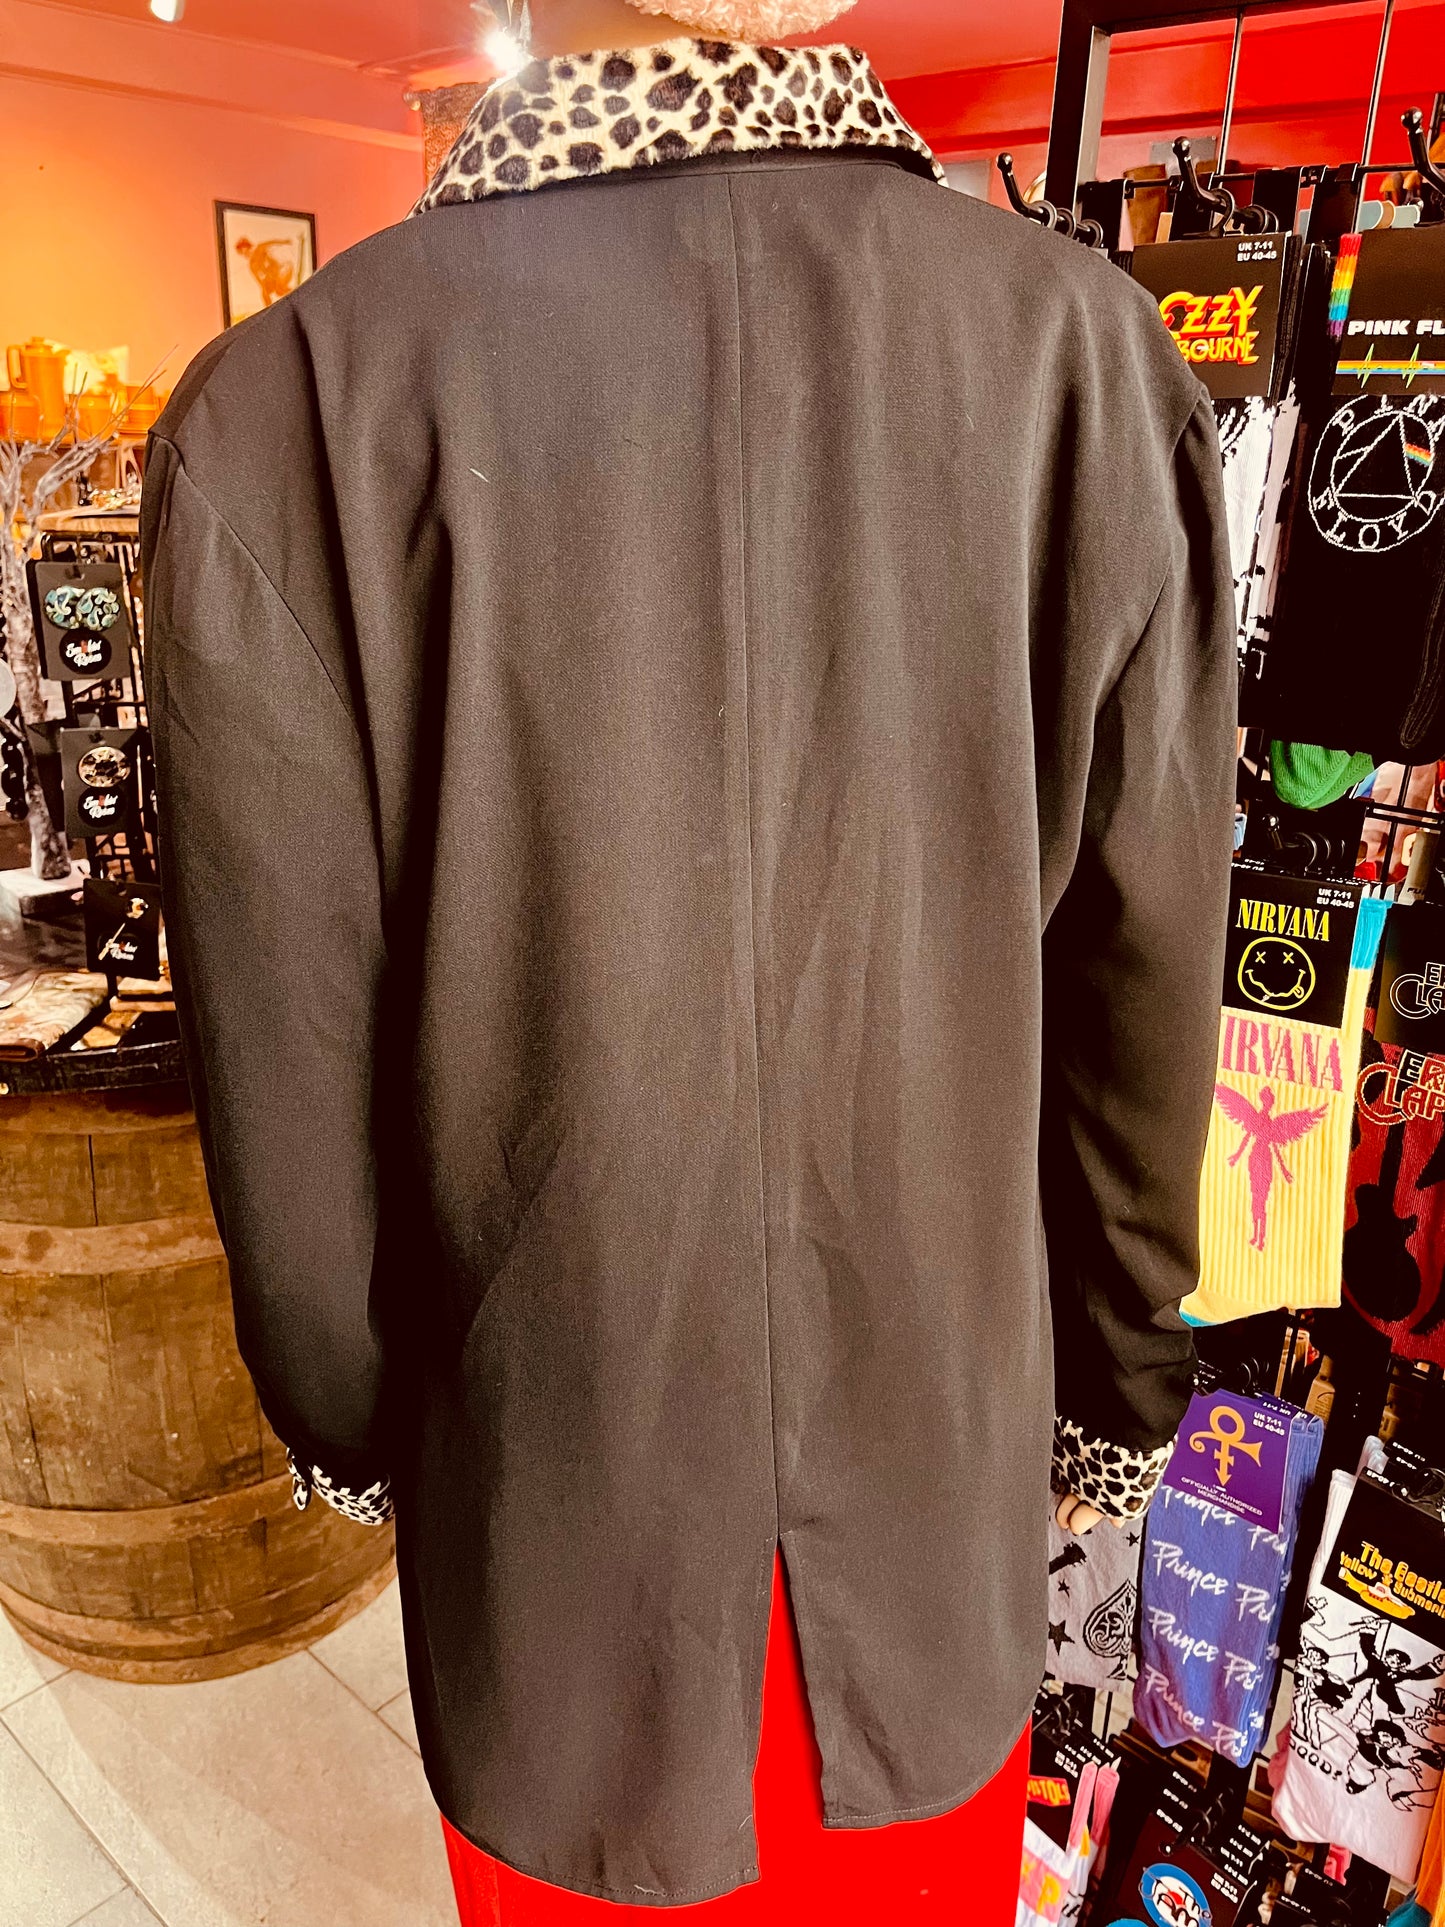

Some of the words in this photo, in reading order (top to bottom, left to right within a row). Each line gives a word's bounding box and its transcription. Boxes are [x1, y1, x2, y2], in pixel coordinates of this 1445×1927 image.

[1237, 252, 1250, 262] EU
[1251, 250, 1277, 260] 40-45
[1238, 242, 1252, 252] UK
[1254, 240, 1273, 250] 7-11
[1159, 285, 1264, 337] OZZY
[1347, 320, 1411, 335] PINK
[1317, 896, 1329, 905] EU
[1330, 898, 1355, 908] 40-45
[1318, 887, 1332, 897] UK
[1333, 890, 1351, 899] 7-11
[1235, 899, 1330, 942] NIRVANA
[1221, 1013, 1343, 1092] IRVANA
[1252, 1419, 1264, 1428] EU
[1264, 1423, 1285, 1436] 40-45
[1254, 1411, 1266, 1421] UK
[1266, 1416, 1282, 1427] 7-11
[1181, 1476, 1218, 1495] OFFICIALLY
[1219, 1492, 1263, 1516] AUTHORIZED
[1197, 1488, 1246, 1514] MERCHANDISE
[1151, 1539, 1229, 1598] Prince
[1340, 1551, 1378, 1580] Yellow
[1361, 1540, 1394, 1574] The
[1148, 1604, 1220, 1665] Prince
